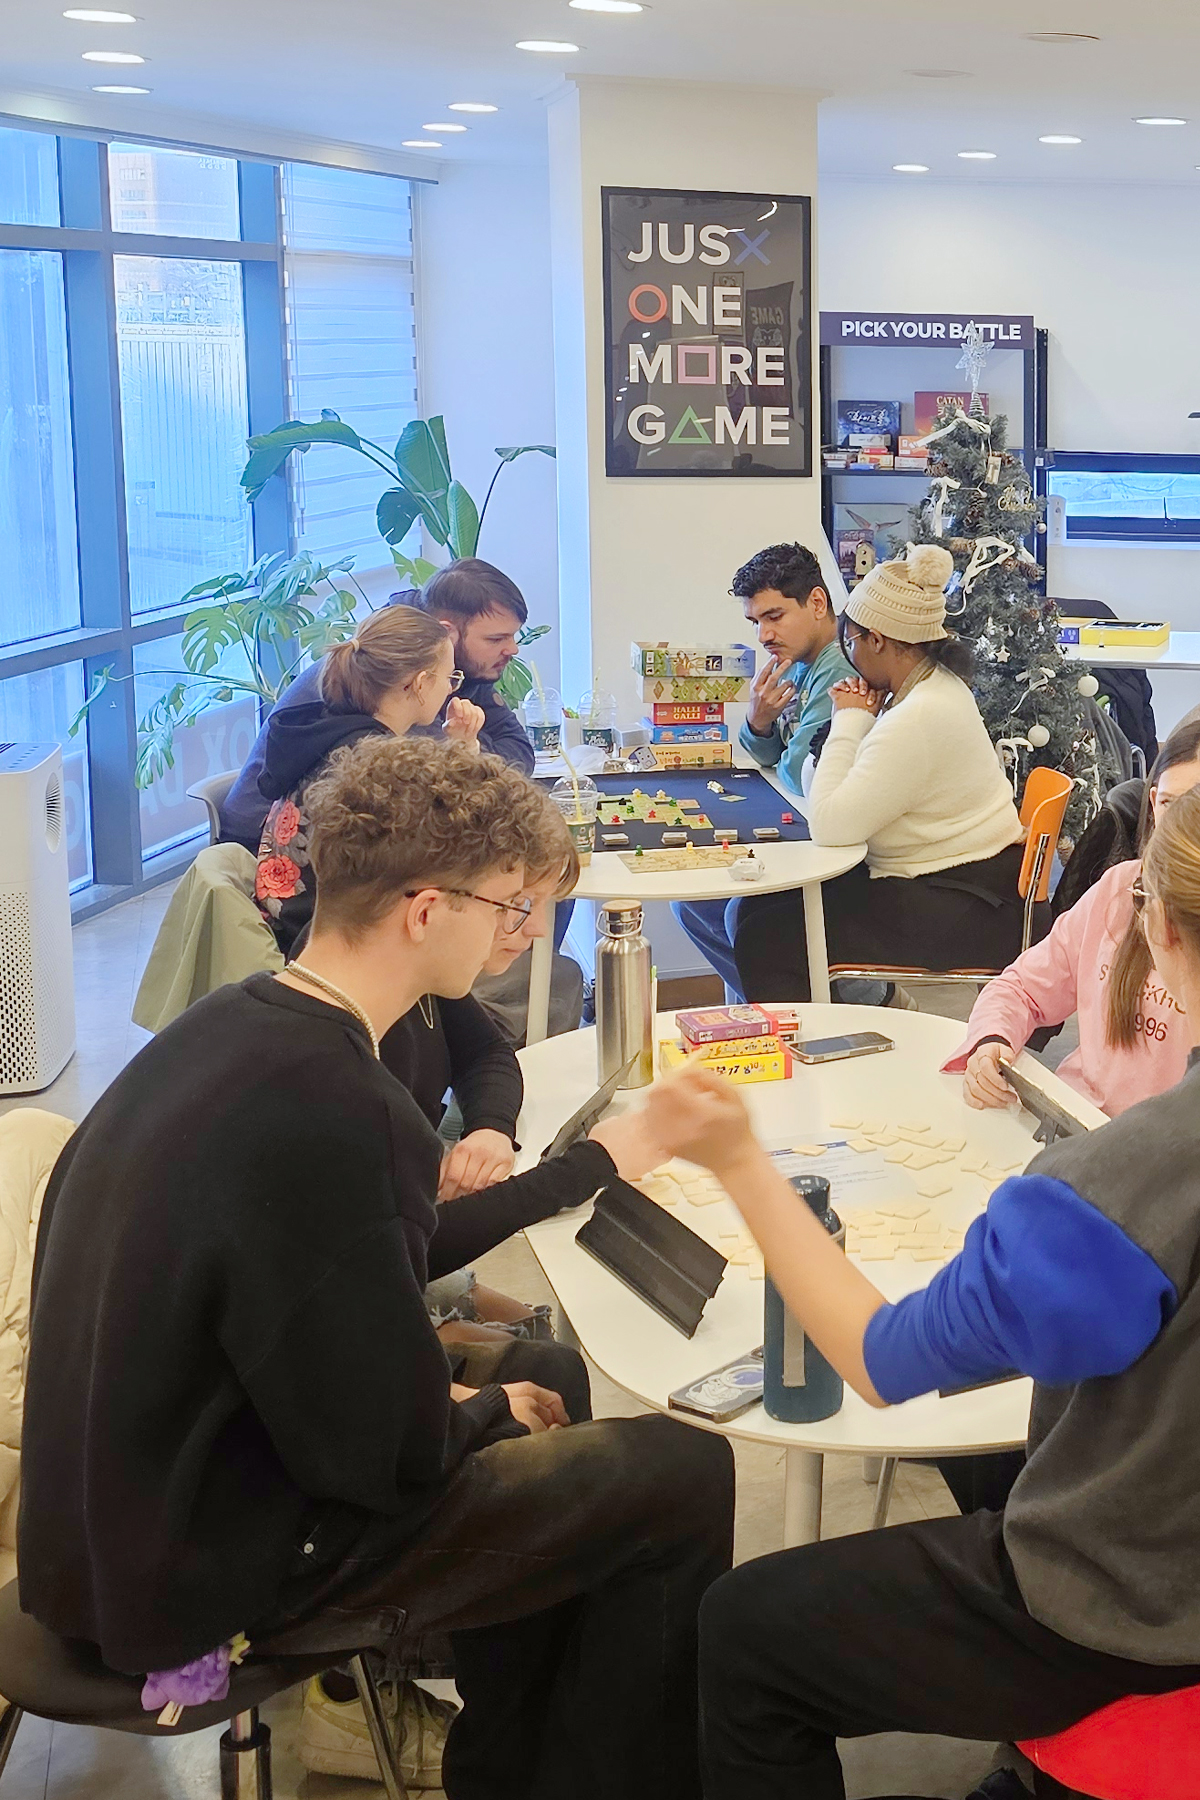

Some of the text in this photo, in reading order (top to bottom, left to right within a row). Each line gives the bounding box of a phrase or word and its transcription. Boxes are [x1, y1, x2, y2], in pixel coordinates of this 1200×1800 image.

[628, 284, 742, 326] ONE
[841, 320, 888, 338] PICK
[891, 321, 946, 339] YOUR
[936, 395, 964, 406] CATAN
[673, 712, 701, 720] GALLI
[1134, 1012, 1168, 1042] 996
